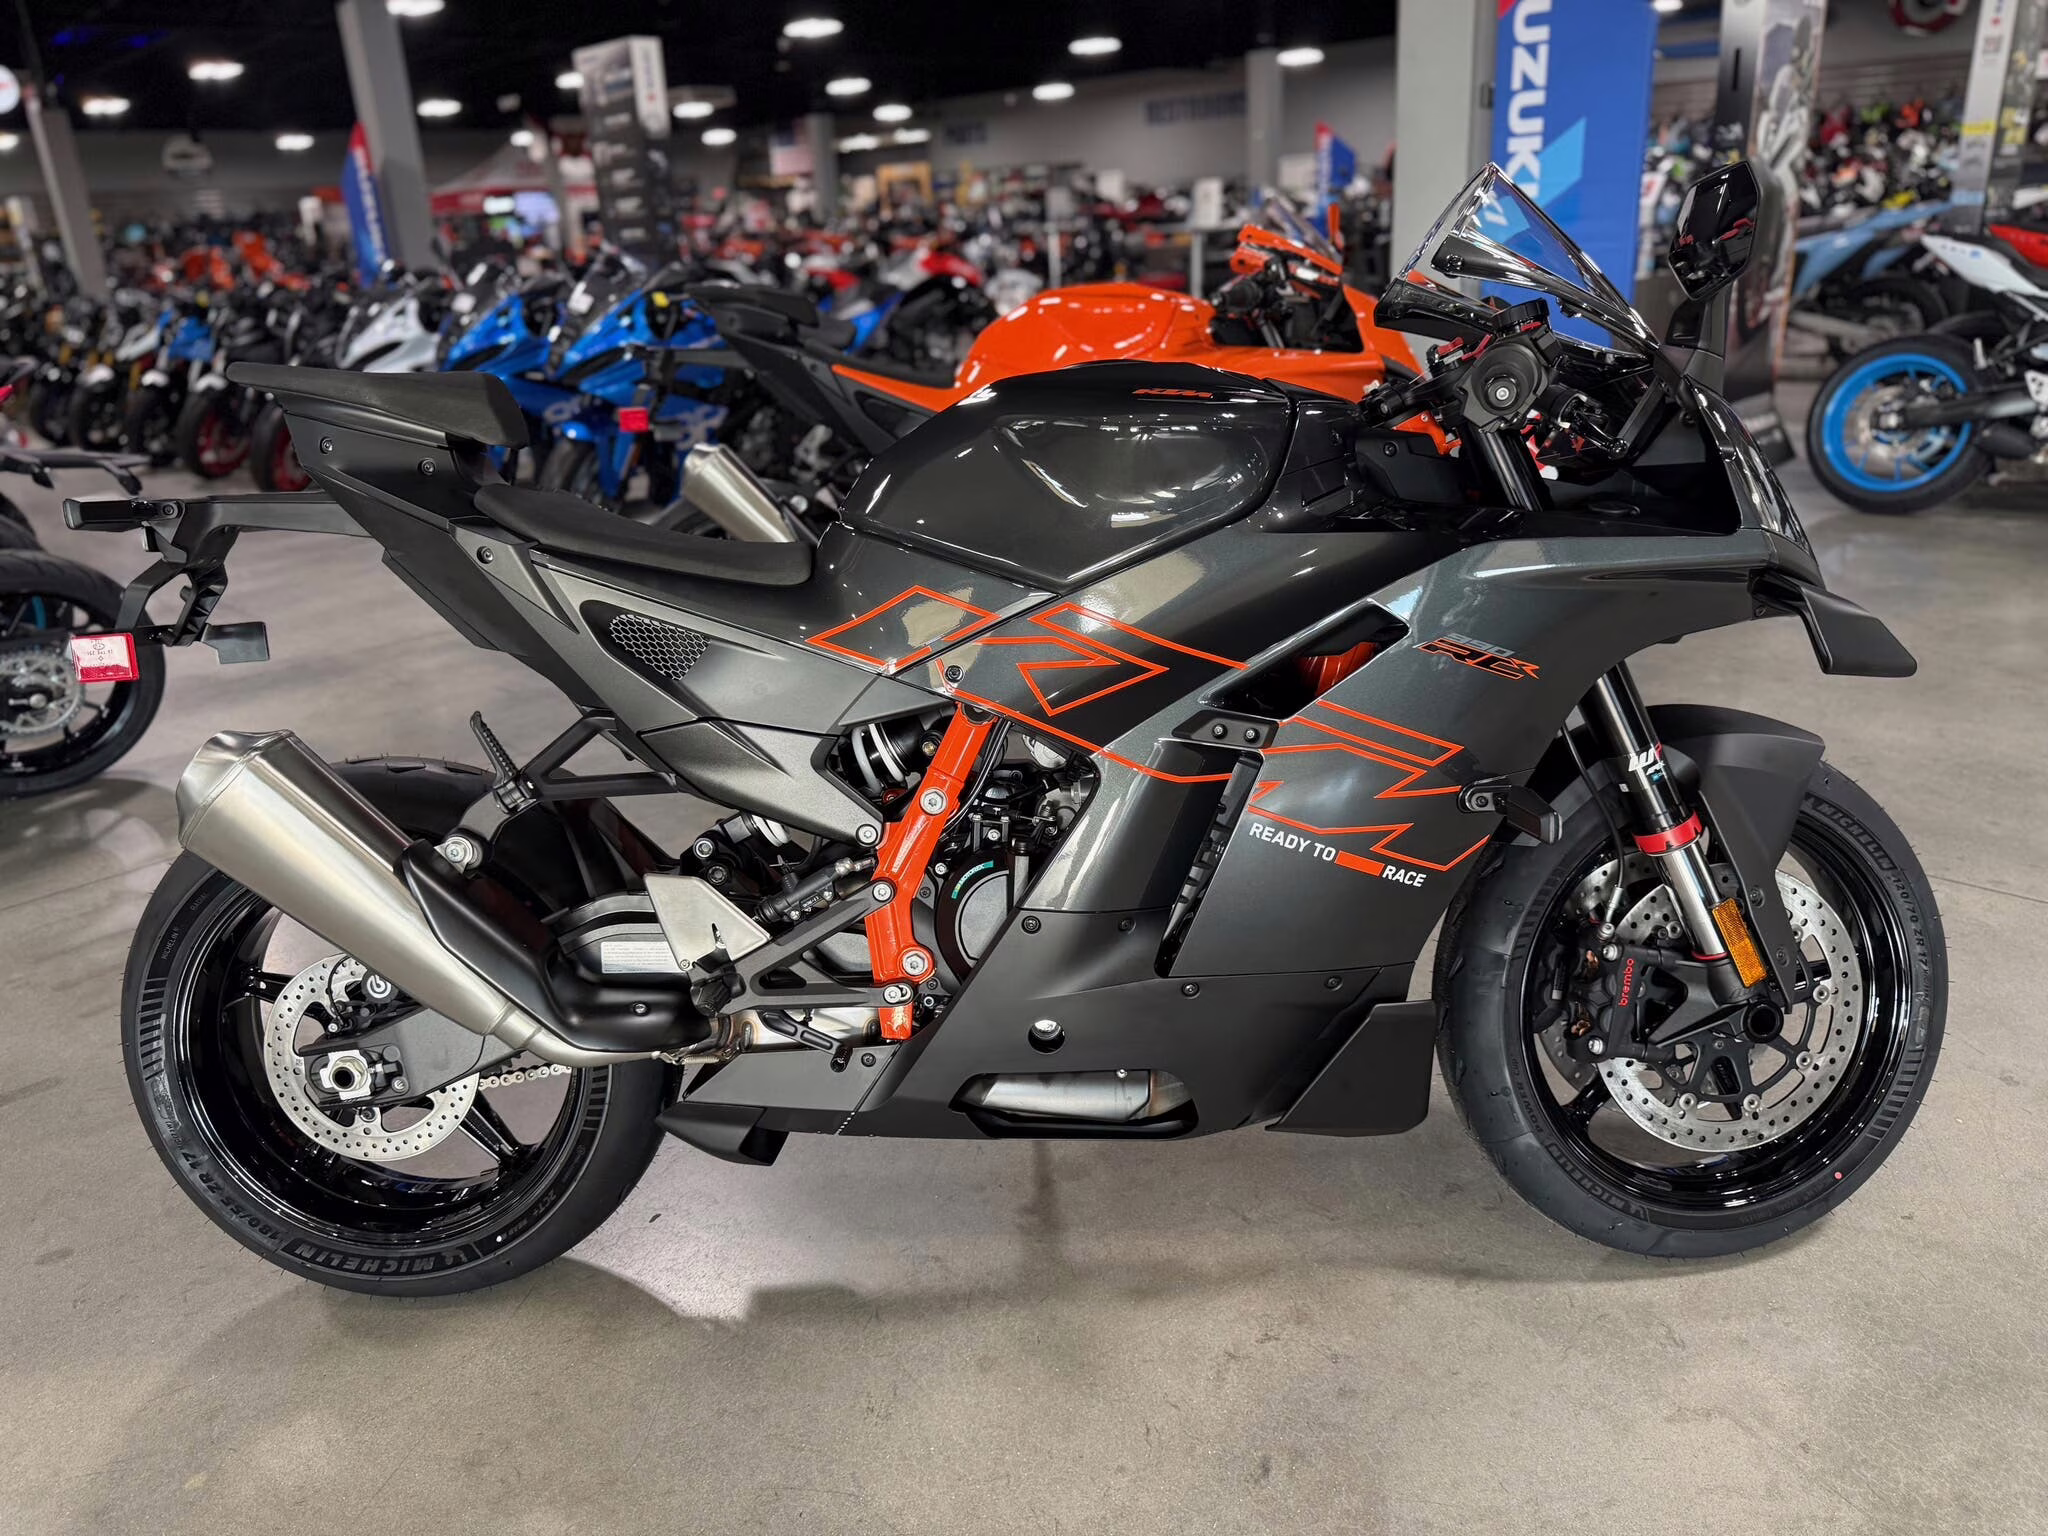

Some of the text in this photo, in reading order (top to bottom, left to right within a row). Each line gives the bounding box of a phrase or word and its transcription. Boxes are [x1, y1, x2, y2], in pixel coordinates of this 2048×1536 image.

[1249, 822, 1427, 887] READY TO RACE
[1817, 803, 1895, 871] MICHELIN
[1891, 874, 1918, 923] 120/70
[1913, 928, 1925, 947] ZR
[1919, 951, 1929, 968] 17
[1618, 958, 1634, 1007] brembo
[181, 1152, 201, 1169] 17
[198, 1172, 223, 1194] ZR
[1548, 1143, 1625, 1208] MICHELIN
[220, 1196, 281, 1240] 180/55
[294, 1243, 435, 1273] MICHELIN
